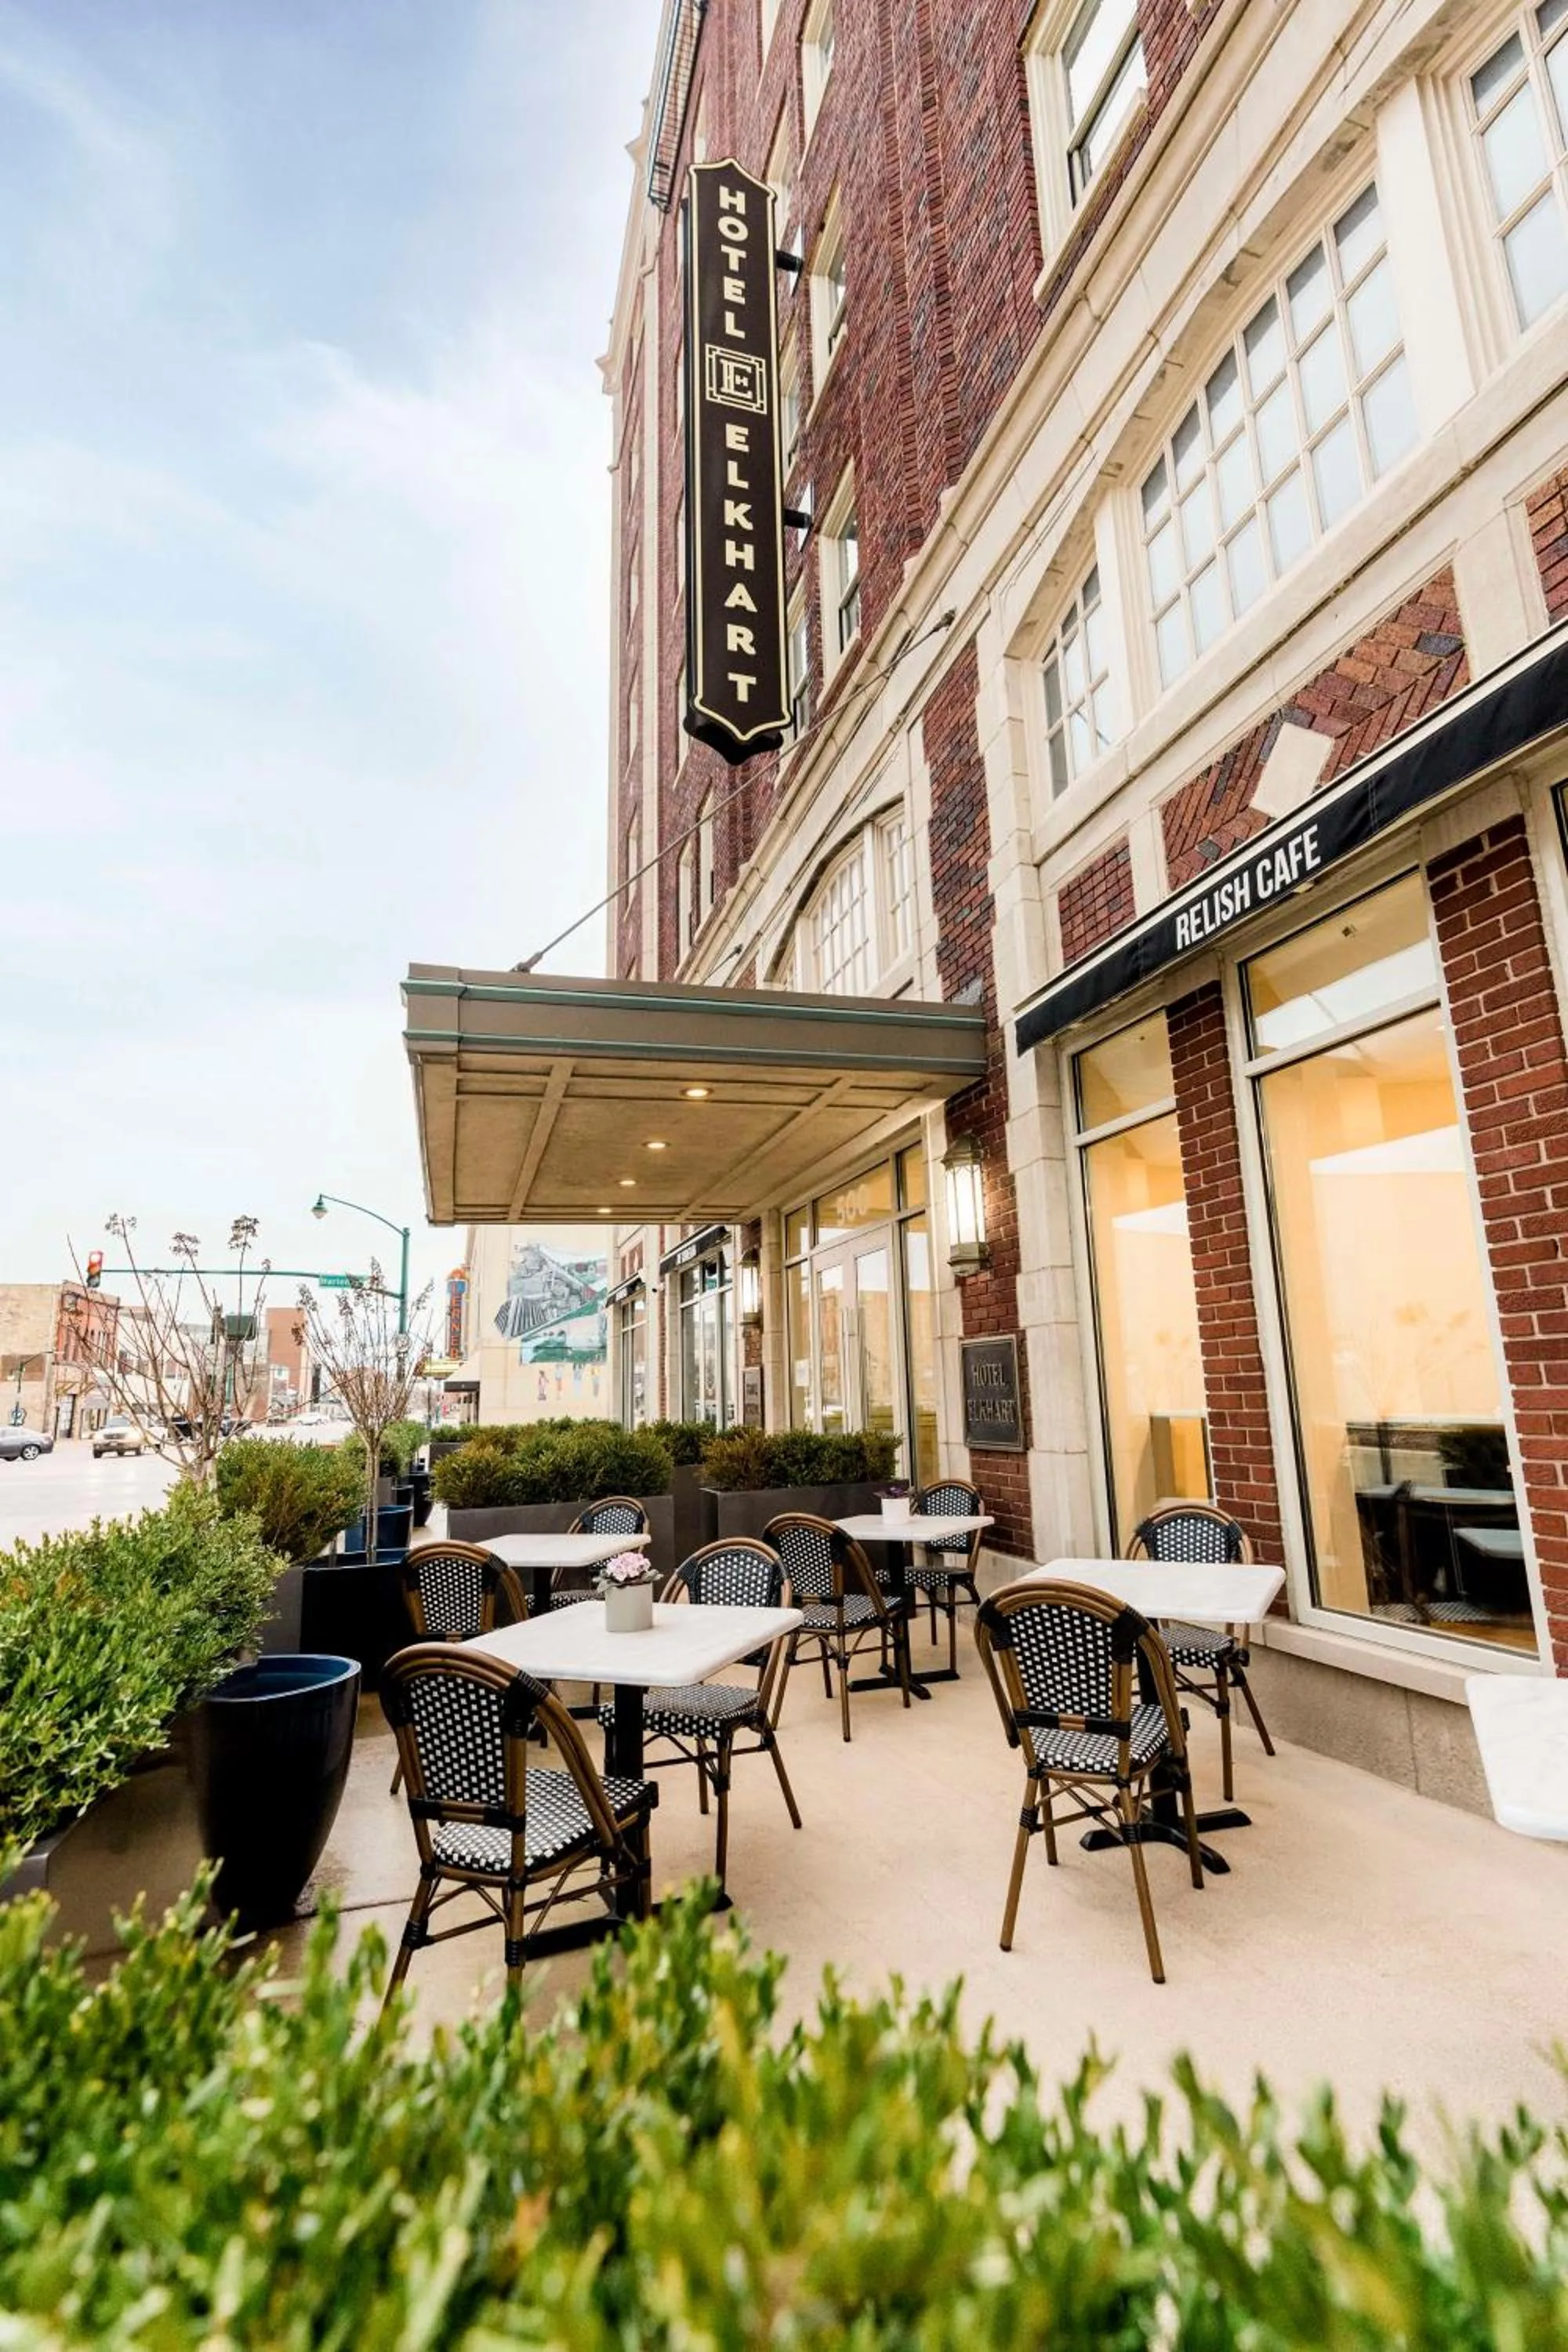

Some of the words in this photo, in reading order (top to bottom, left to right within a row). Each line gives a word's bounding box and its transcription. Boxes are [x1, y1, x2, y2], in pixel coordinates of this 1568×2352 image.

[719, 184, 748, 339] HOTEL
[724, 423, 758, 703] ELKHART
[1176, 870, 1250, 951] RELISH
[1256, 824, 1321, 899] CAFE
[451, 1281, 463, 1359] LERNER
[967, 1399, 1015, 1423] ELKHART
[971, 1363, 1006, 1387] HOTEL
